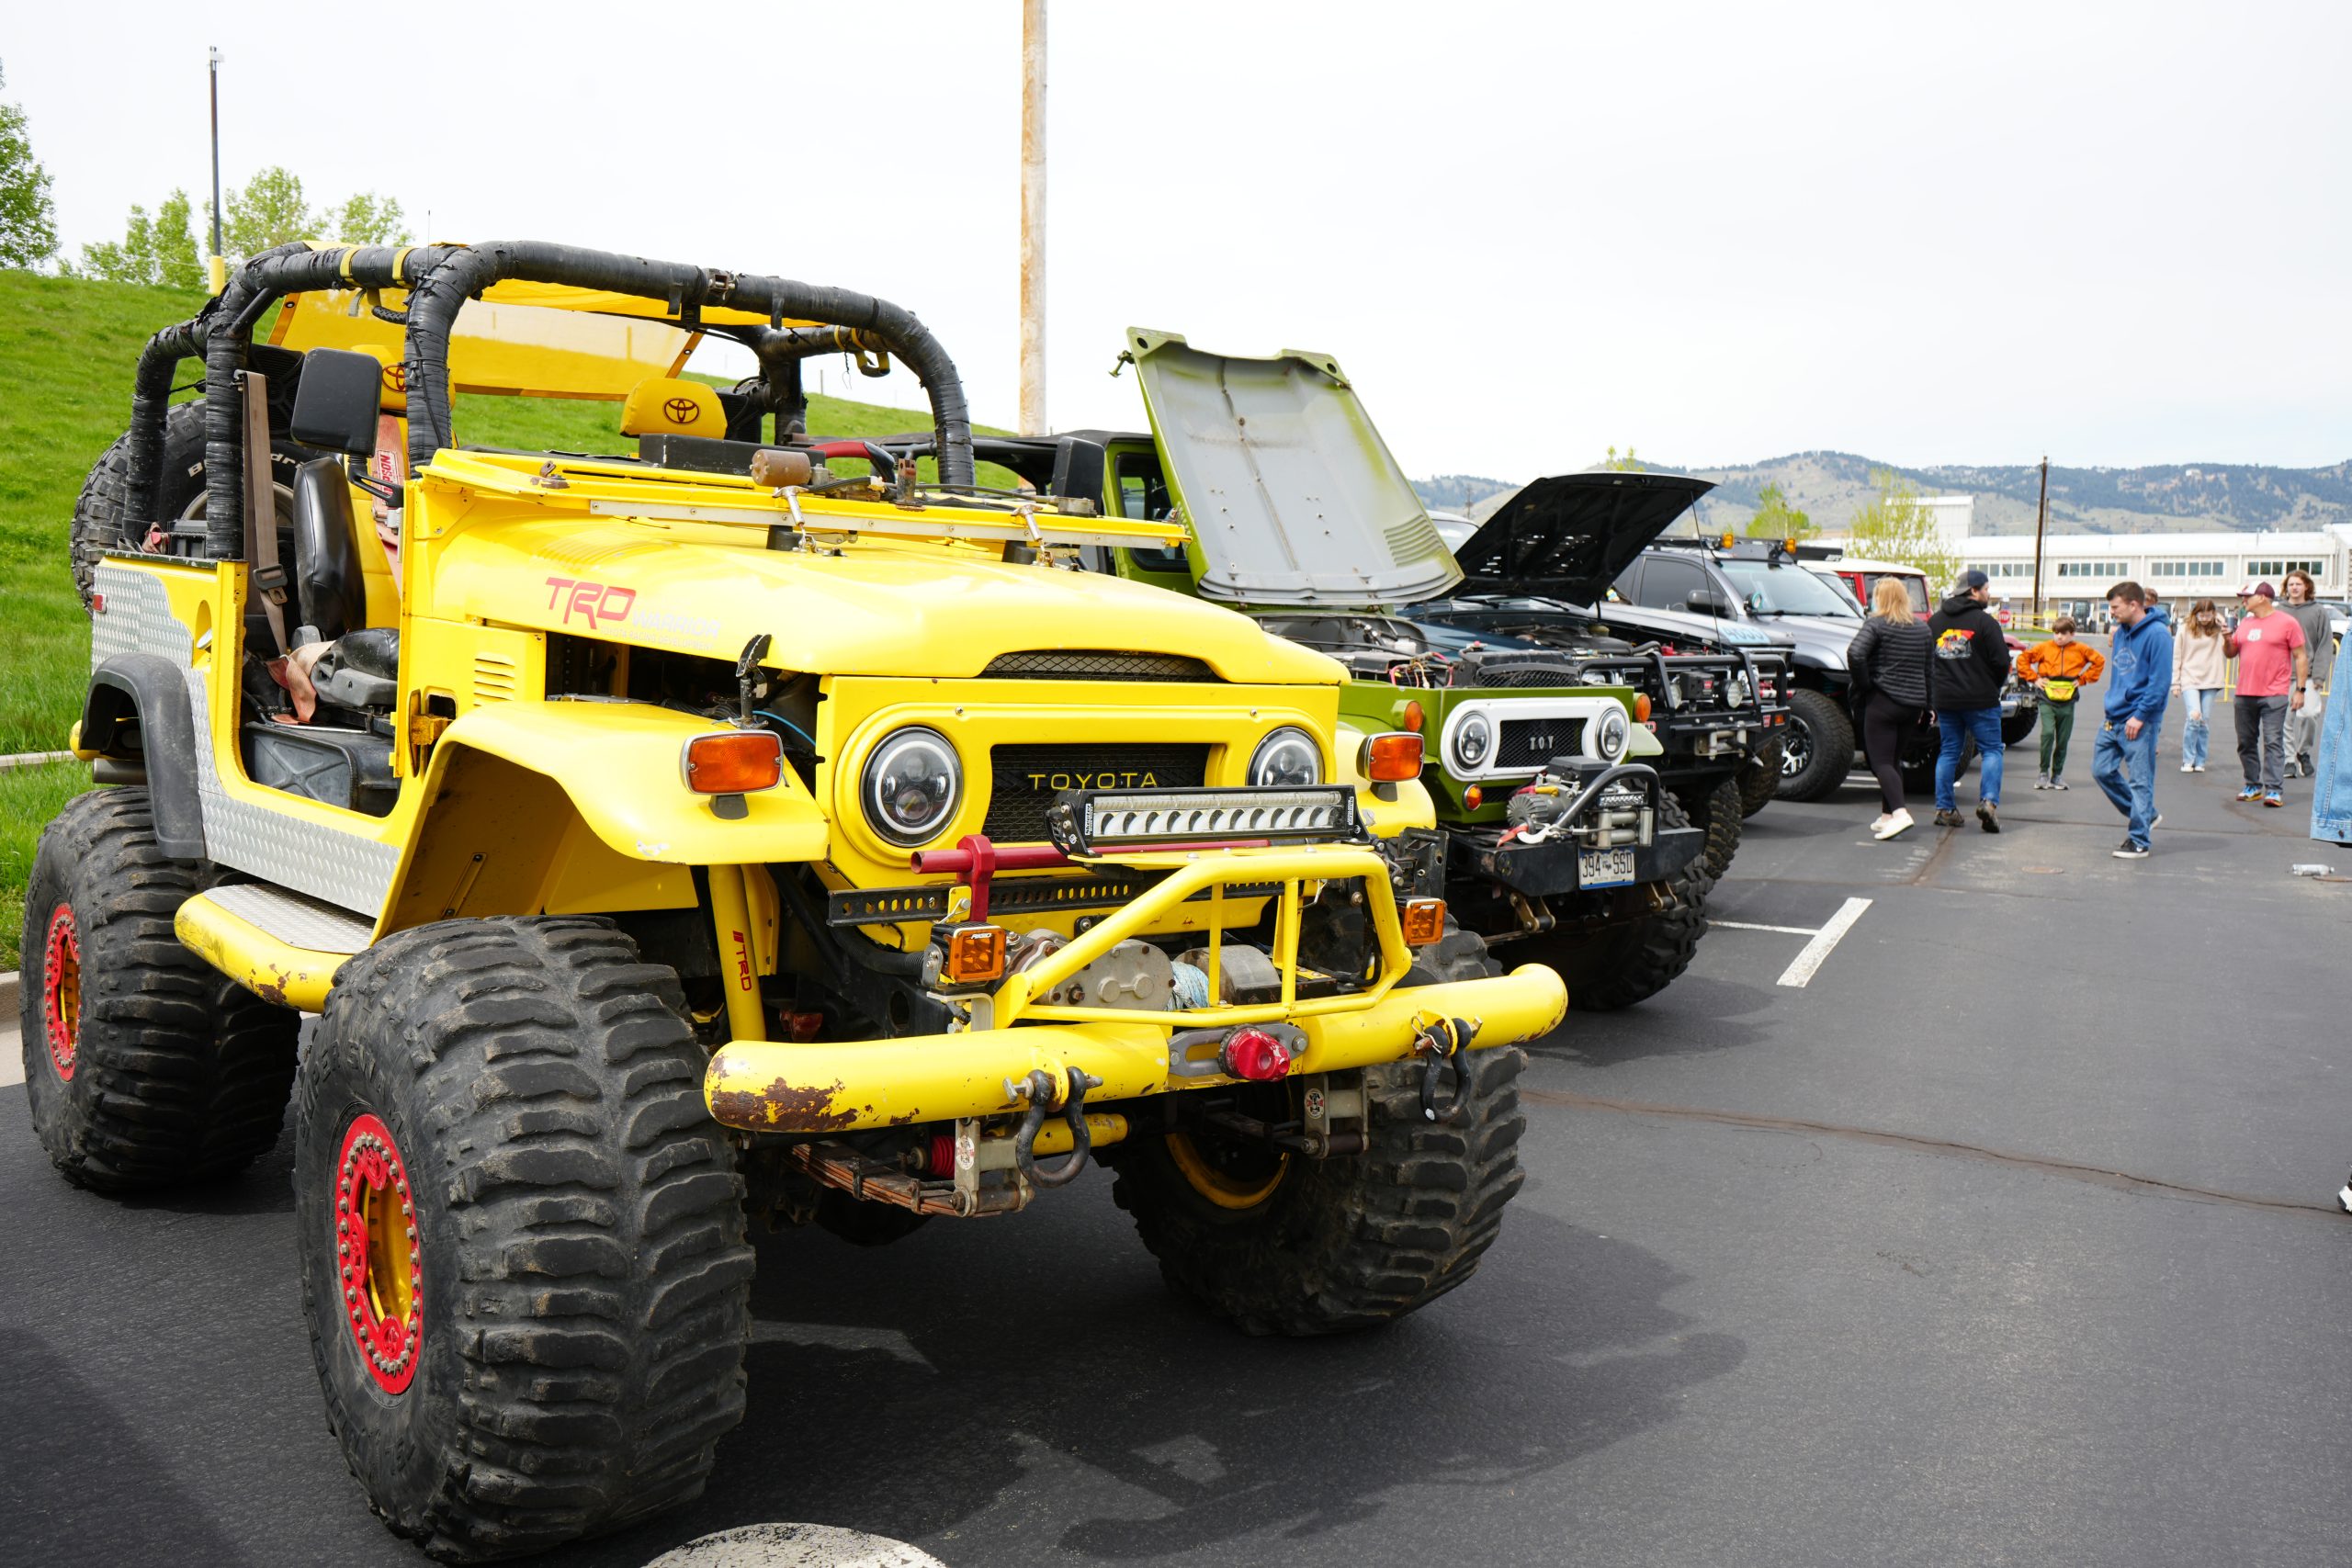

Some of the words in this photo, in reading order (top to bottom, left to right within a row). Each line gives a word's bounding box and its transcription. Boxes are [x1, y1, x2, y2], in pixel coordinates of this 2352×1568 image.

[546, 577, 637, 629] TRD
[632, 609, 720, 638] WARRIOR
[629, 630, 656, 643] RACING
[1530, 736, 1555, 750] TOY
[1028, 773, 1158, 790] TOYOTA
[1582, 855, 1600, 877] 394
[736, 944, 752, 991] TRD
